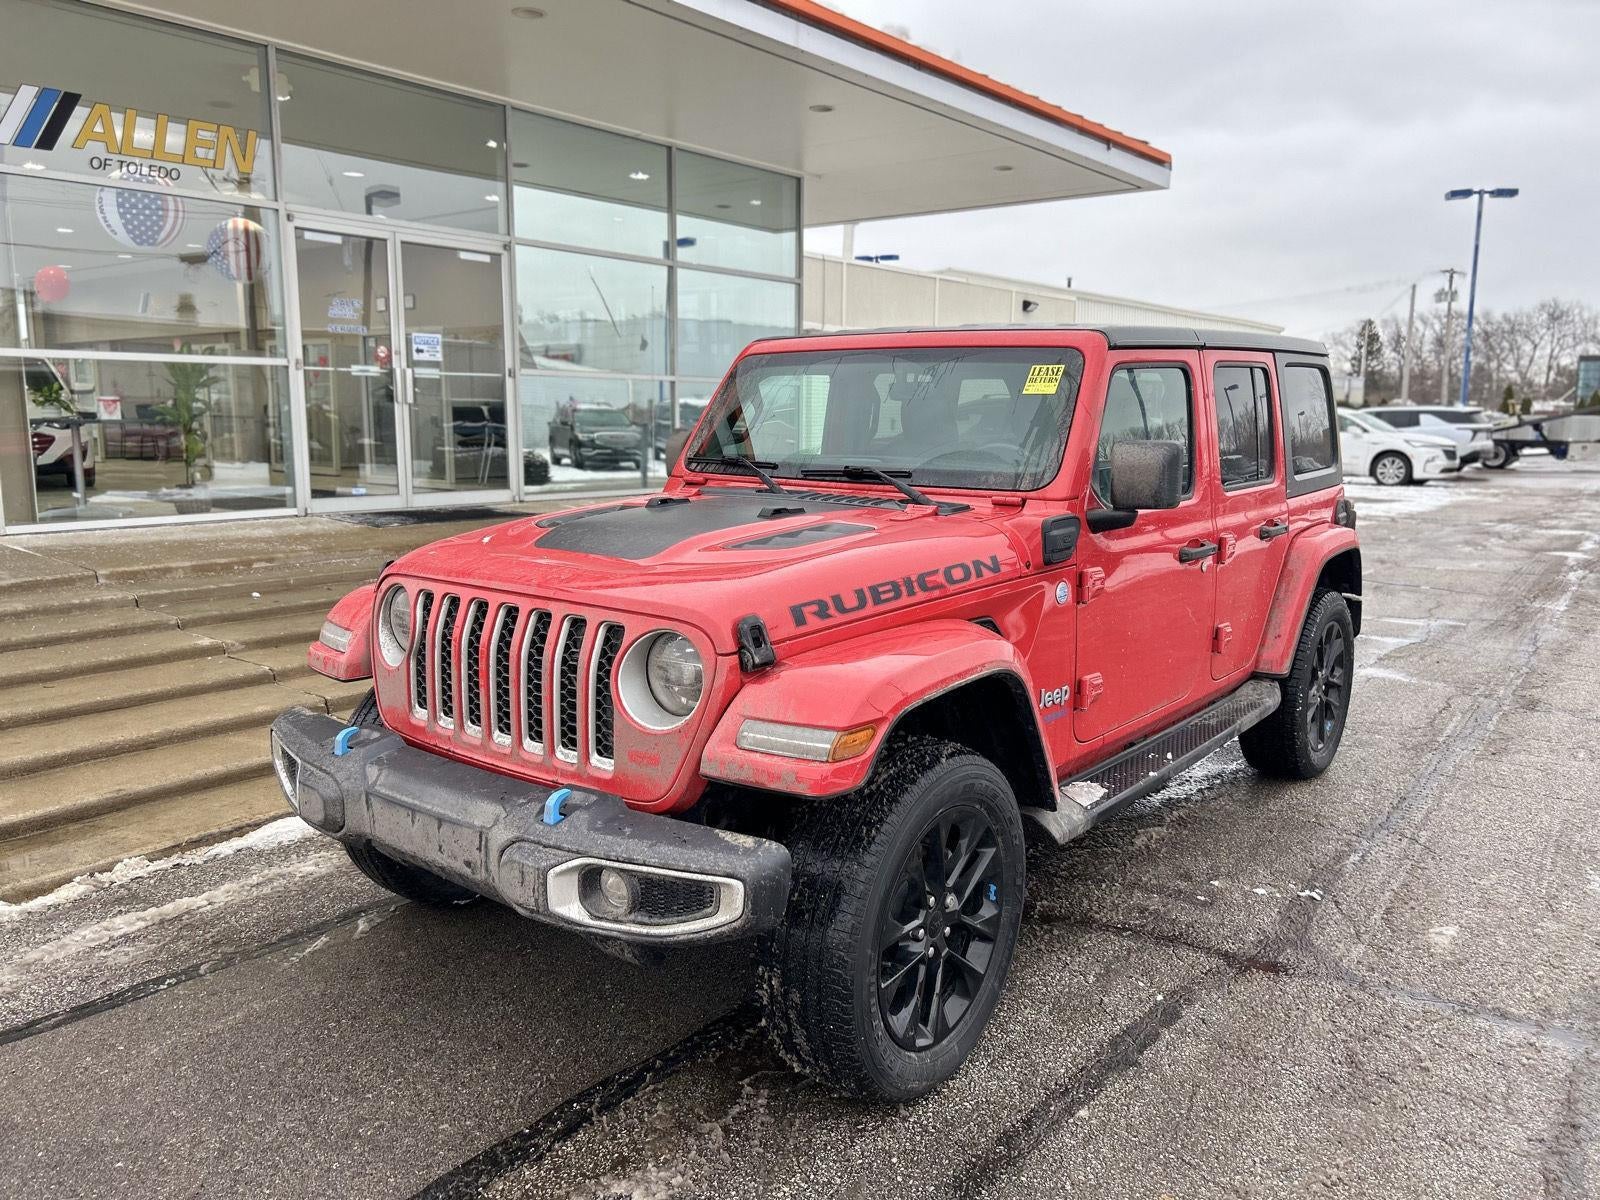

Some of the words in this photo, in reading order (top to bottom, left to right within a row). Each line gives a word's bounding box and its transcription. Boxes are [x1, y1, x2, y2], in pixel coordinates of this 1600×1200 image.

[72, 102, 257, 174] ALLEN
[90, 156, 113, 171] OF
[117, 160, 181, 181] TOLEDO
[415, 336, 439, 345] NOTICE
[1031, 366, 1062, 376] LEASE
[789, 554, 1001, 627] RUBICON
[1039, 685, 1070, 710] Jeep
